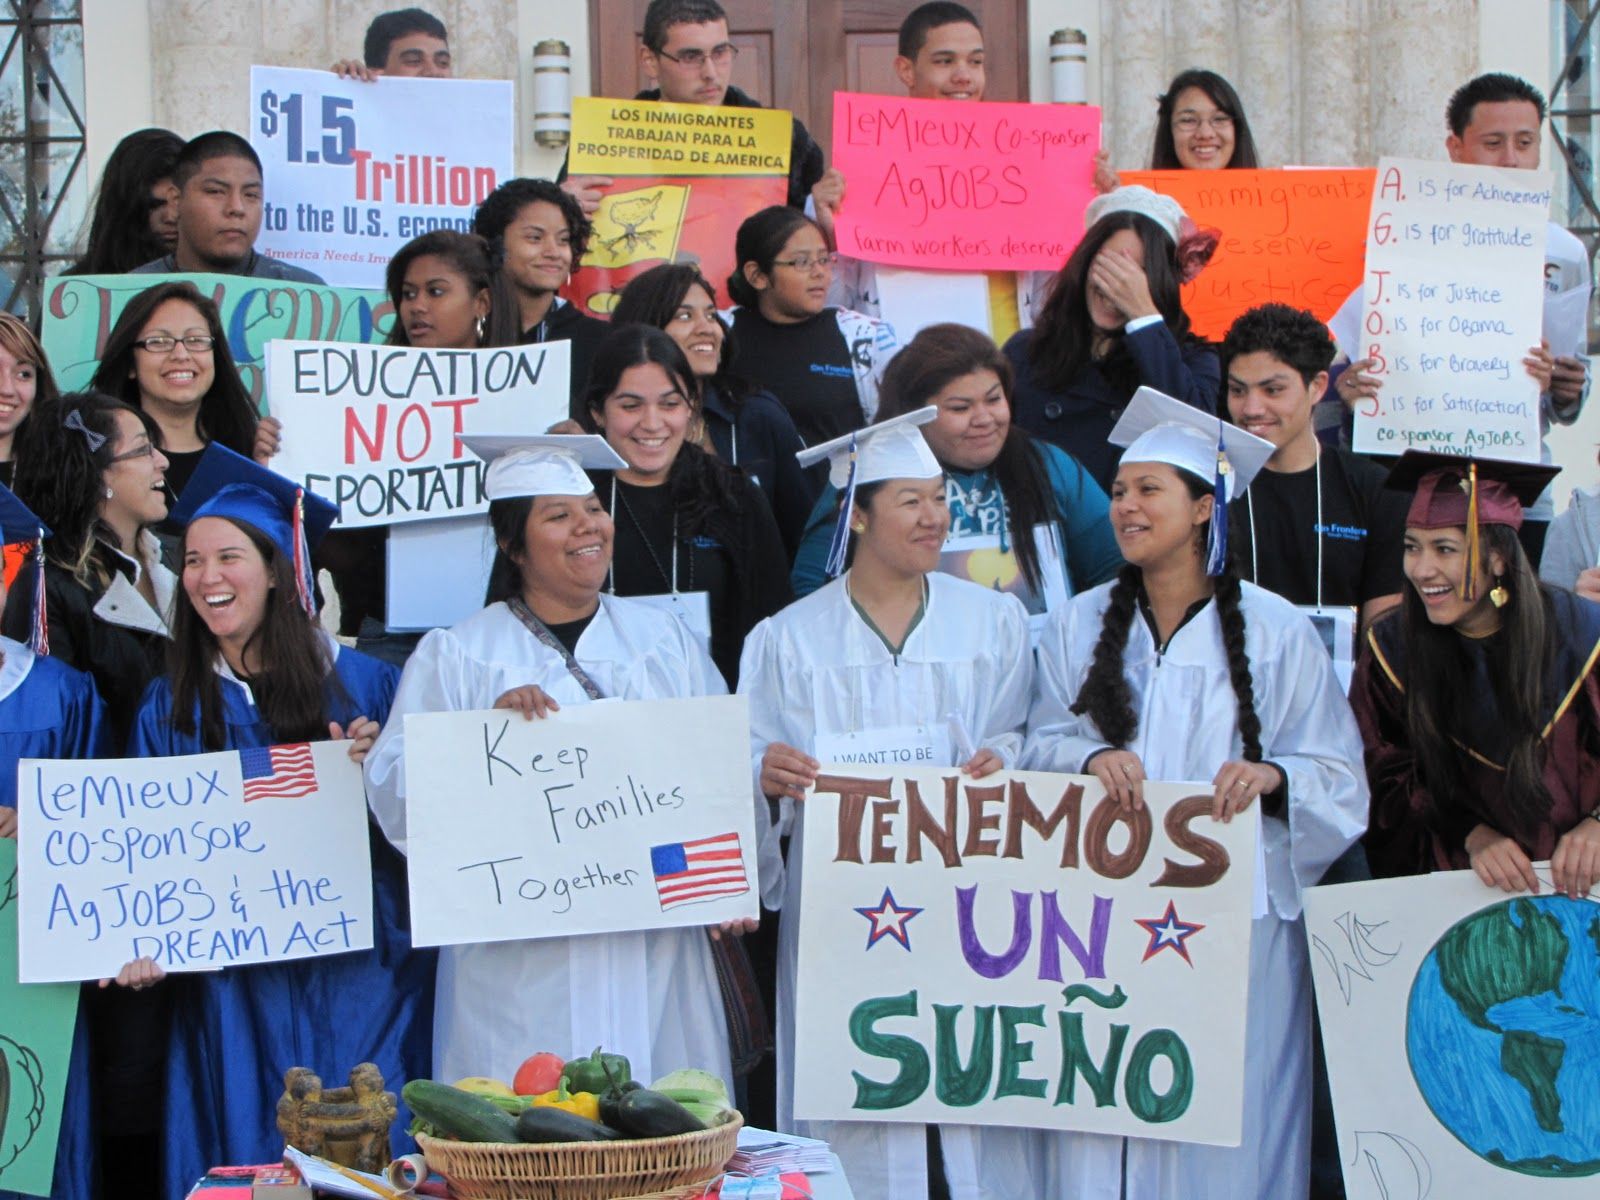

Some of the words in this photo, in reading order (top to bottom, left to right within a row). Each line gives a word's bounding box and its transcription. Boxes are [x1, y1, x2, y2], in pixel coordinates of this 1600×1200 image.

[611, 108, 640, 122] LOS
[645, 111, 755, 130] INMIGRANTES
[260, 89, 356, 166] $1.5
[351, 149, 496, 207] Trillion
[577, 142, 685, 162] PROSPERIDAD
[690, 151, 710, 164] DE
[714, 153, 784, 169] AMERICA
[607, 126, 688, 144] TRABAJAN
[692, 133, 733, 147] PARA
[738, 135, 757, 149] LA
[874, 162, 1028, 228] AgJOBS
[1444, 178, 1469, 202] for
[1471, 182, 1550, 208] Achievement
[265, 202, 287, 231] to
[297, 203, 334, 233] the
[343, 206, 389, 238] U.S.
[1429, 224, 1456, 245] for
[323, 250, 365, 263] Needs
[1000, 236, 1066, 258] deserve
[1417, 283, 1438, 302] for
[1446, 283, 1502, 303] Justice
[1420, 316, 1443, 337] for
[294, 348, 548, 399] EDUCATION
[1419, 353, 1444, 373] for
[1413, 396, 1435, 414] for
[344, 397, 480, 465] NOT
[483, 719, 589, 786] Keep
[840, 750, 887, 764] WANT
[890, 749, 911, 763] TO
[915, 746, 933, 761] BE
[543, 775, 685, 843] Families
[813, 774, 1231, 888] TENEMOS
[260, 868, 343, 910] the
[457, 856, 640, 914] Together
[133, 925, 270, 965] DREAM
[955, 882, 1114, 983] UN
[848, 983, 1194, 1123] SUEÑO
